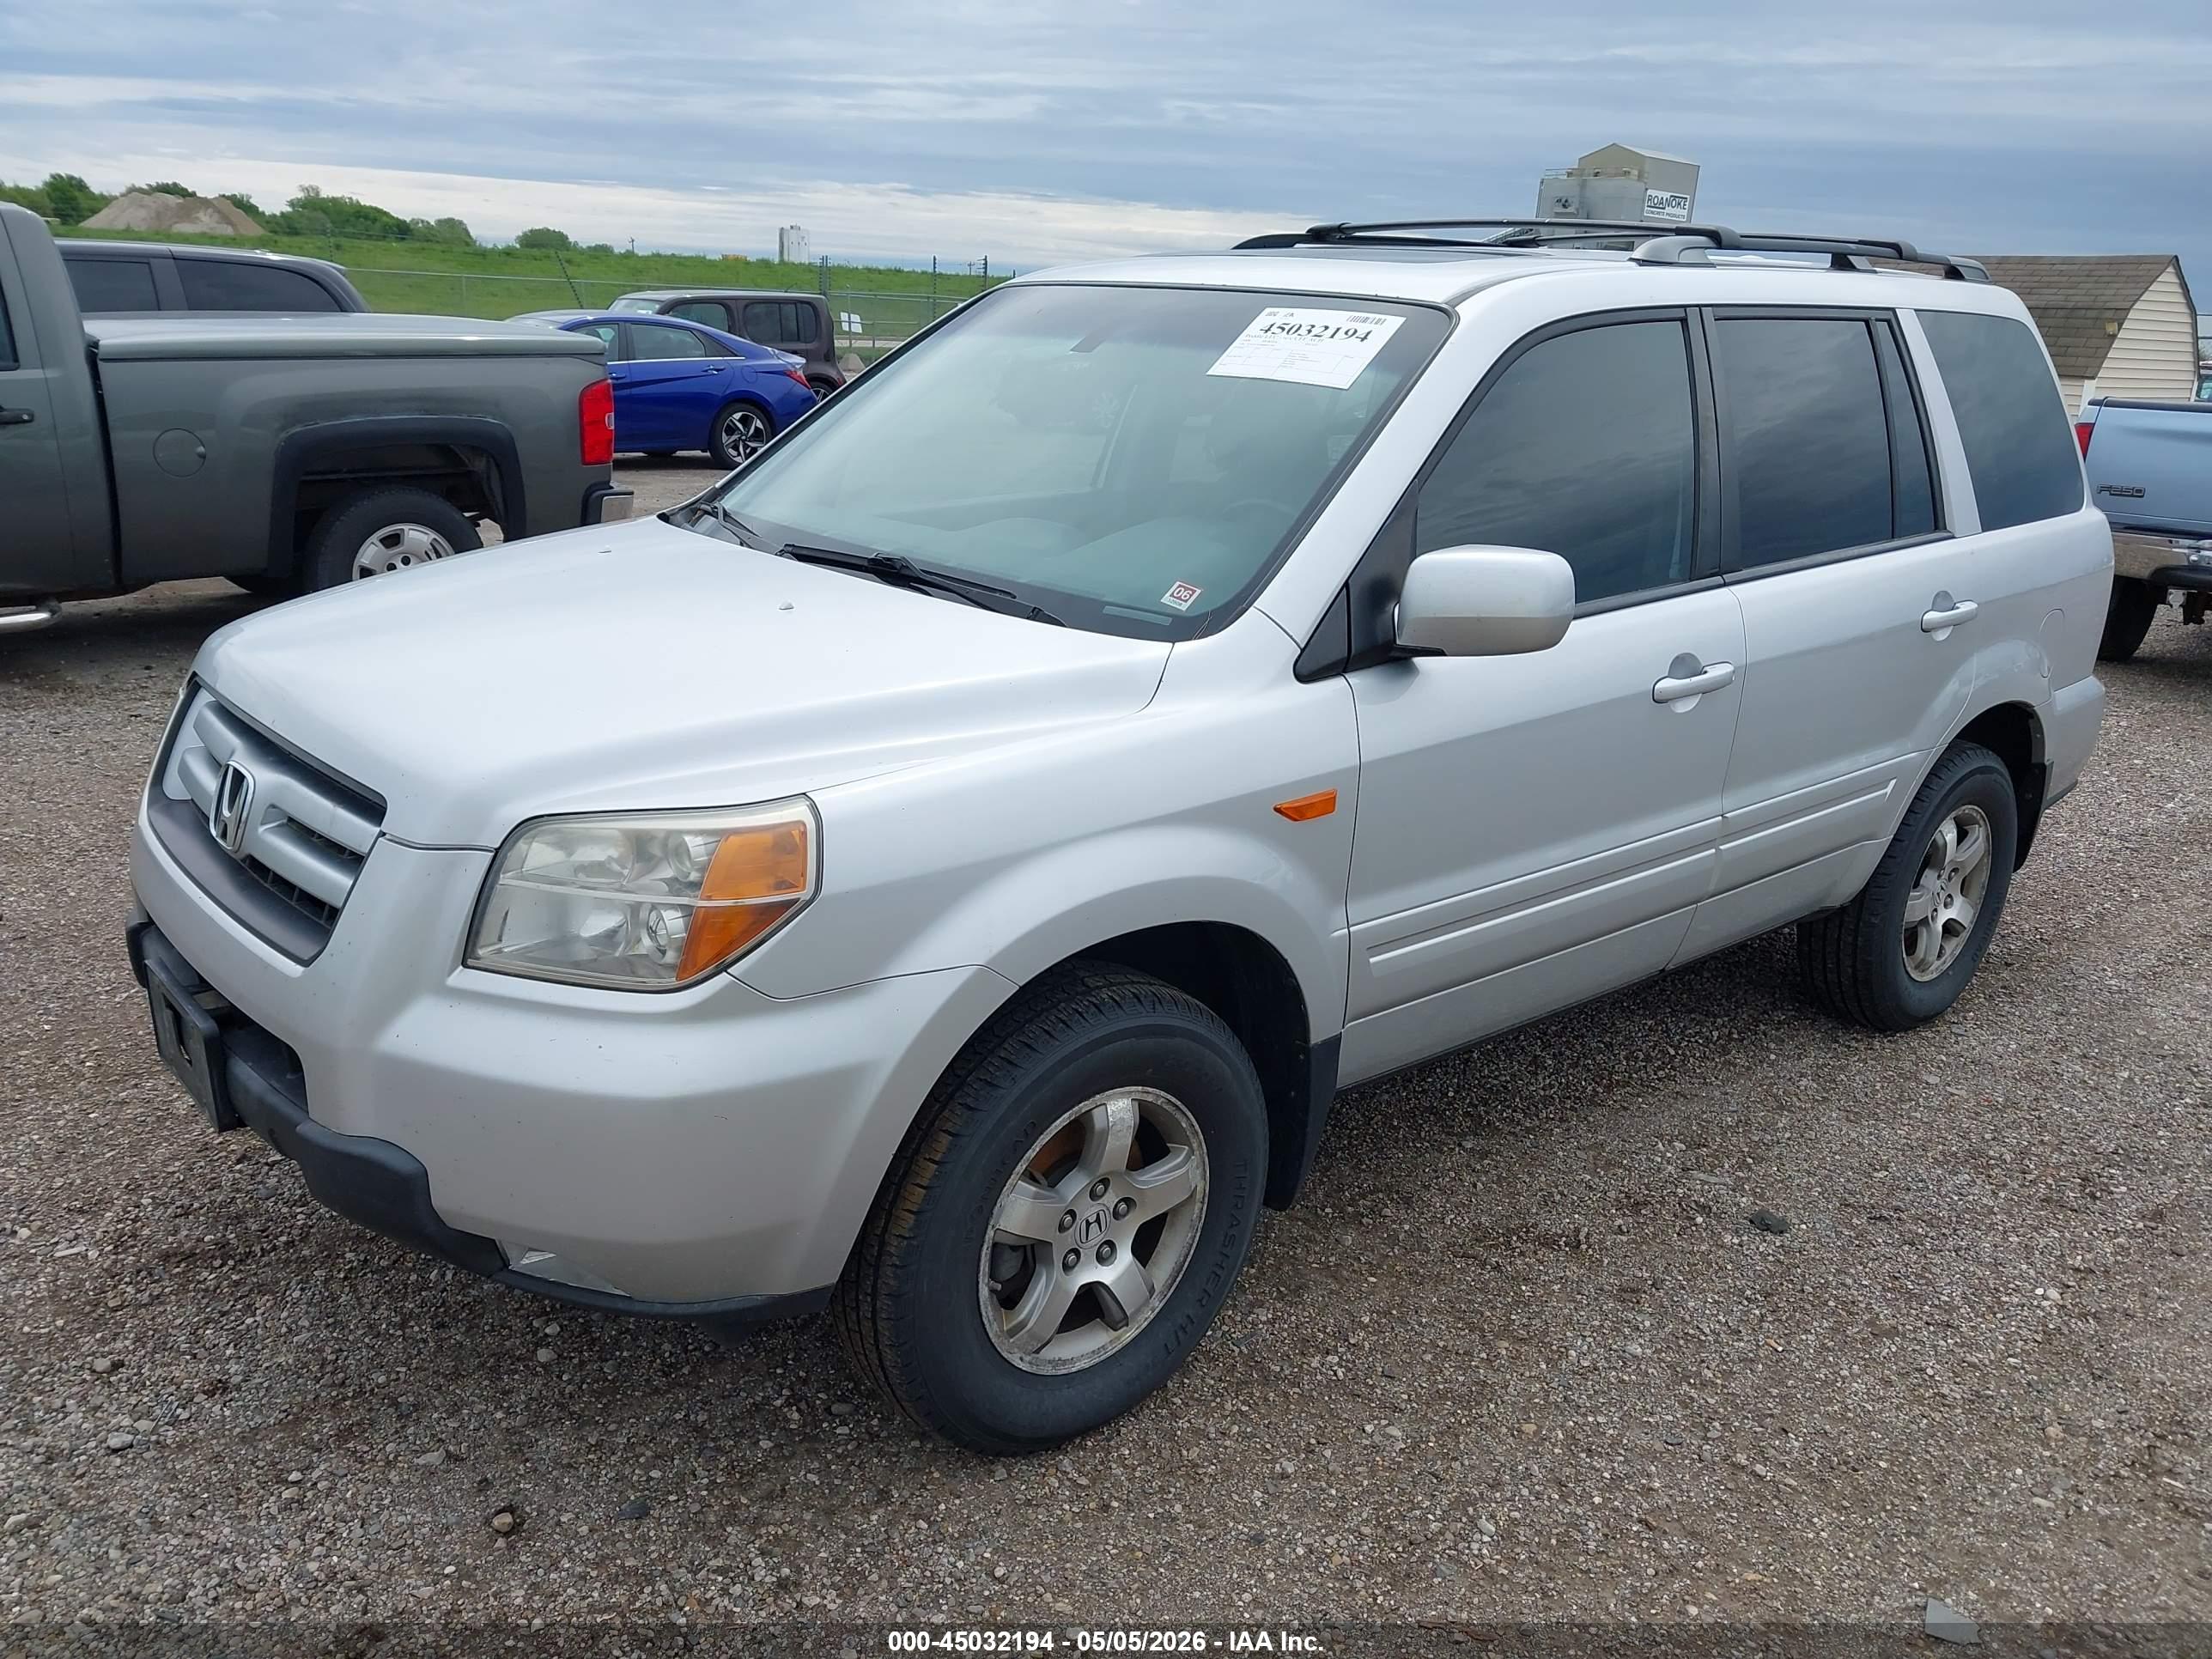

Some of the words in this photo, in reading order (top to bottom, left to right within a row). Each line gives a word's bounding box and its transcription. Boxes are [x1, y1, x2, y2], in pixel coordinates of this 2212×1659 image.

[1647, 194, 1688, 210] ROANOKE
[1260, 322, 1373, 343] 45032194
[1173, 586, 1193, 600] 06
[1196, 1162, 1248, 1308] THRASHER
